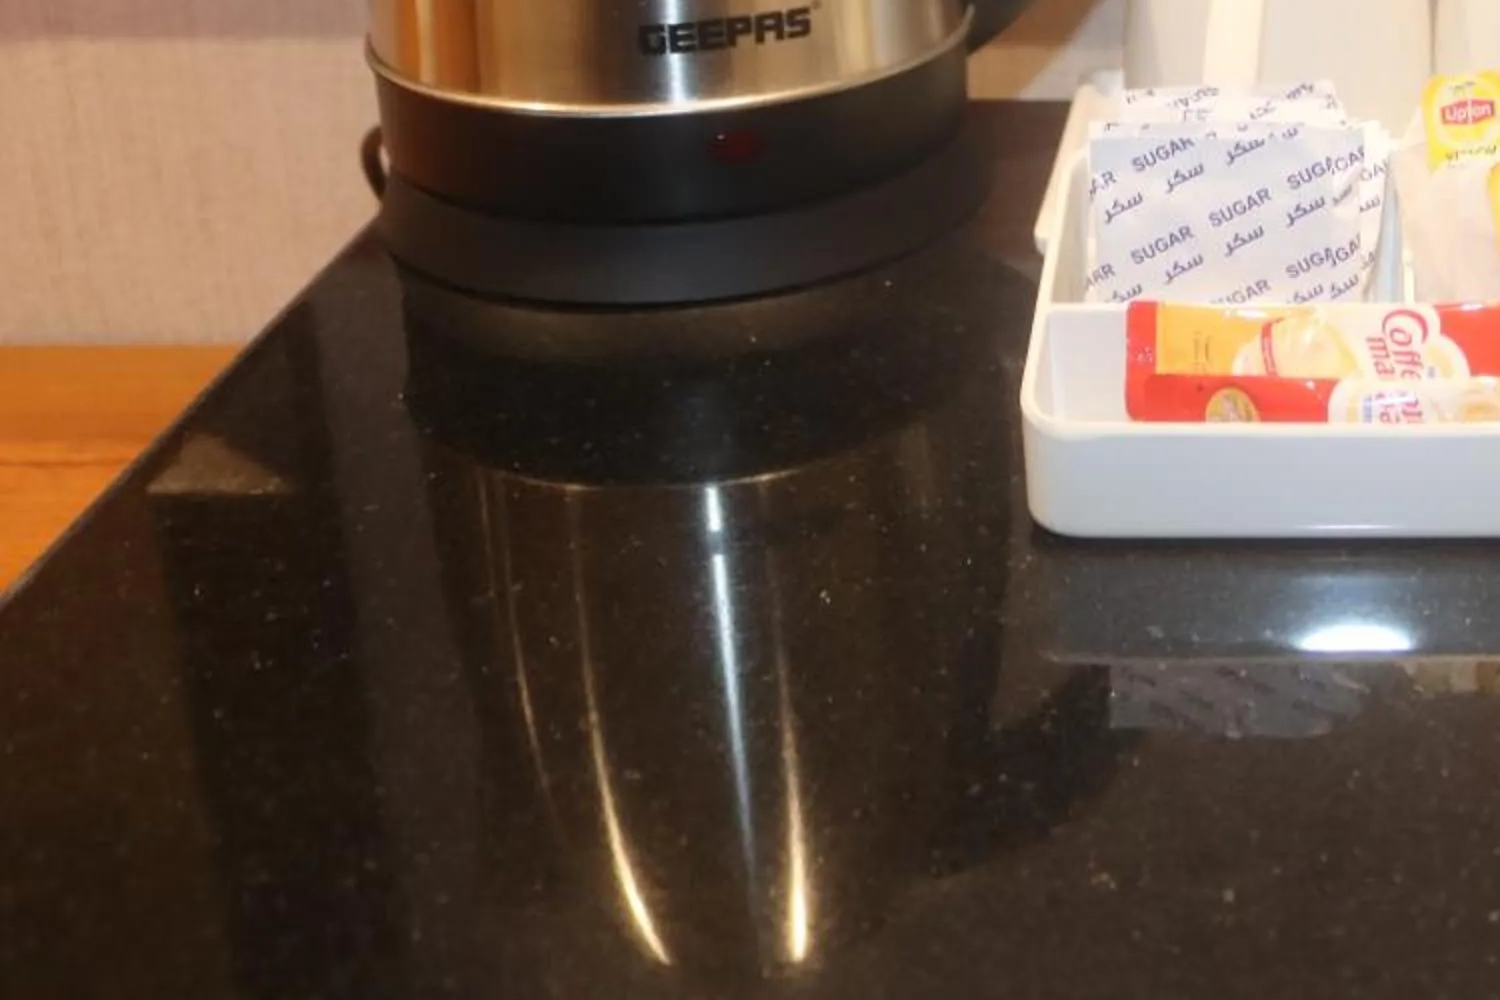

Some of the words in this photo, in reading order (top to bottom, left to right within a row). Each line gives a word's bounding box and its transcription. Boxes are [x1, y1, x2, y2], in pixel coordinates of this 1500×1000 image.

[638, 6, 811, 56] GEEPAS
[1130, 225, 1194, 265] SUGAR
[1208, 187, 1272, 228] SUGAR
